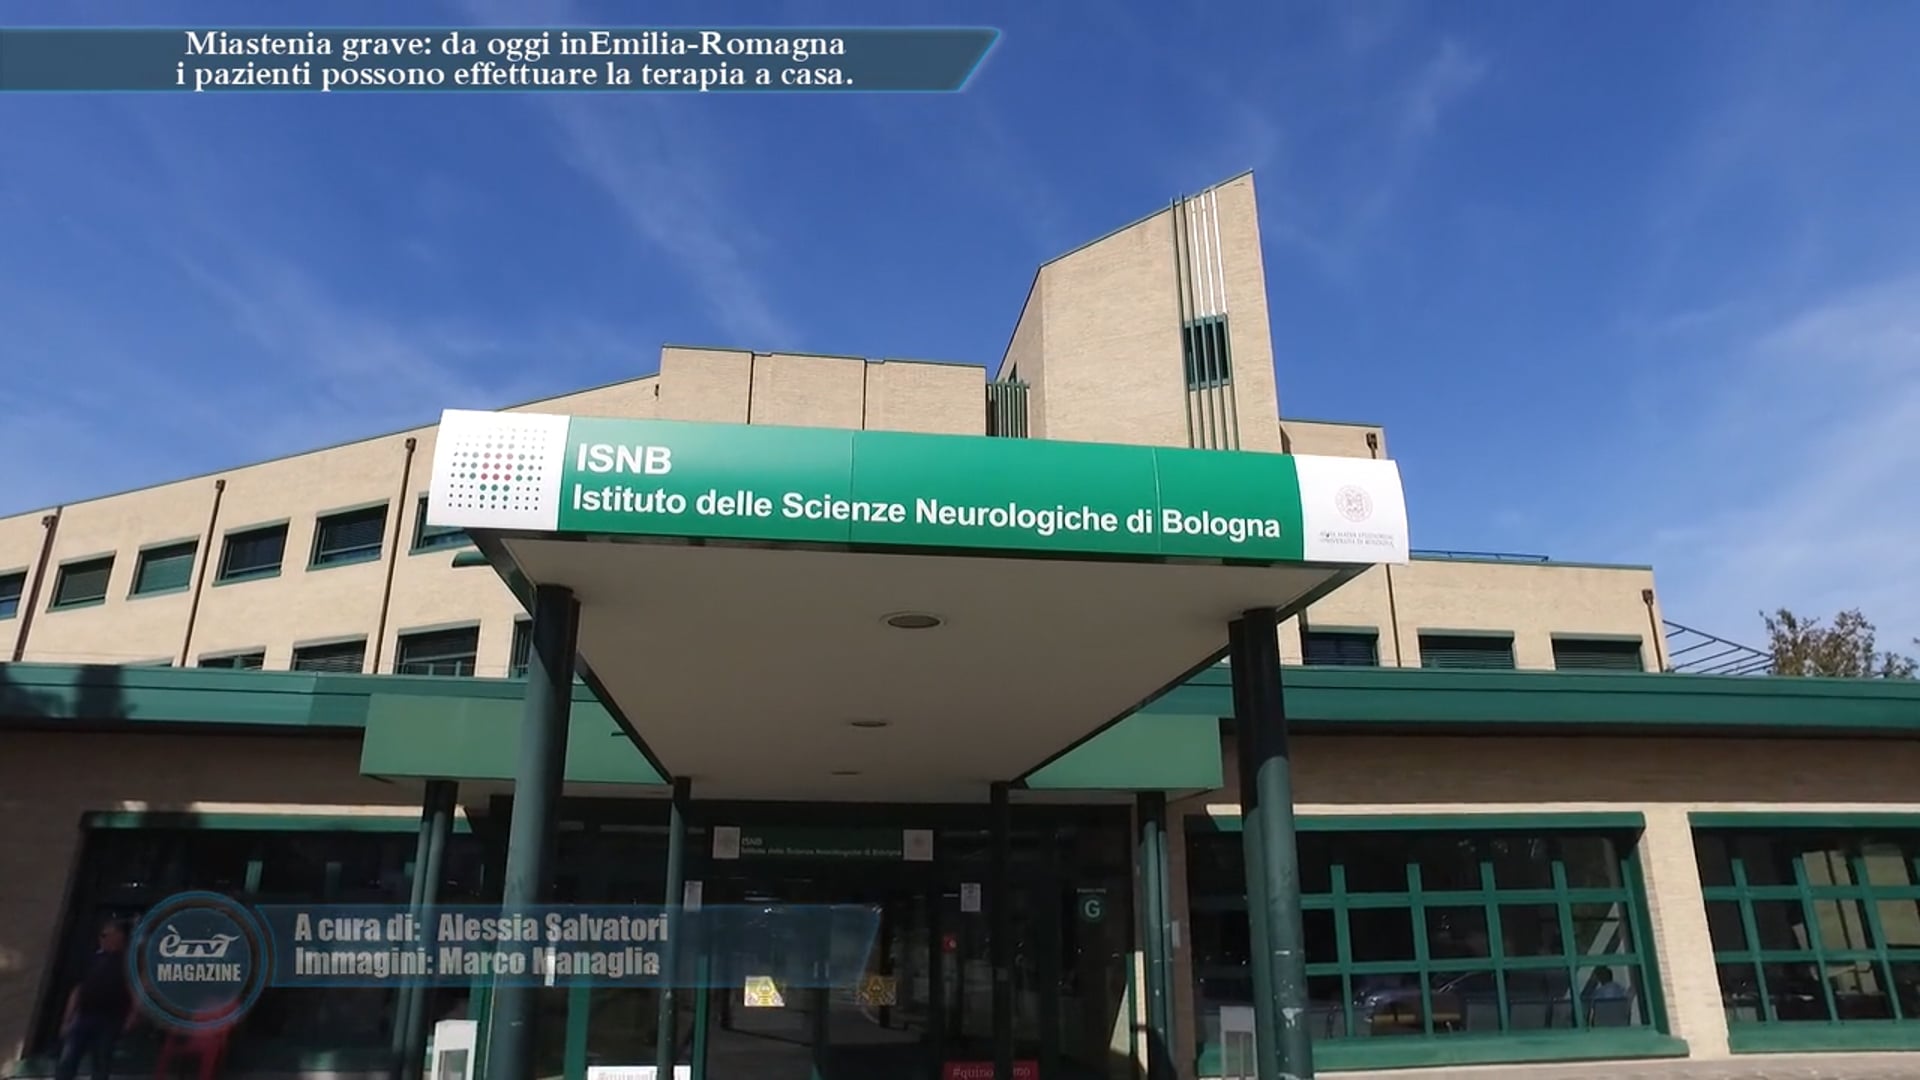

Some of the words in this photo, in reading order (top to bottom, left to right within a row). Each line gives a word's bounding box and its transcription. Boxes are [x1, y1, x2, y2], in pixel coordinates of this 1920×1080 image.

[576, 443, 672, 475] ISNB
[572, 484, 686, 514] Istituto
[696, 489, 773, 517] delle
[782, 492, 906, 523] Scienze
[916, 498, 1118, 536] Neurologiche
[1126, 507, 1153, 534] di
[1162, 509, 1280, 543] Bologna
[1084, 899, 1101, 918] G
